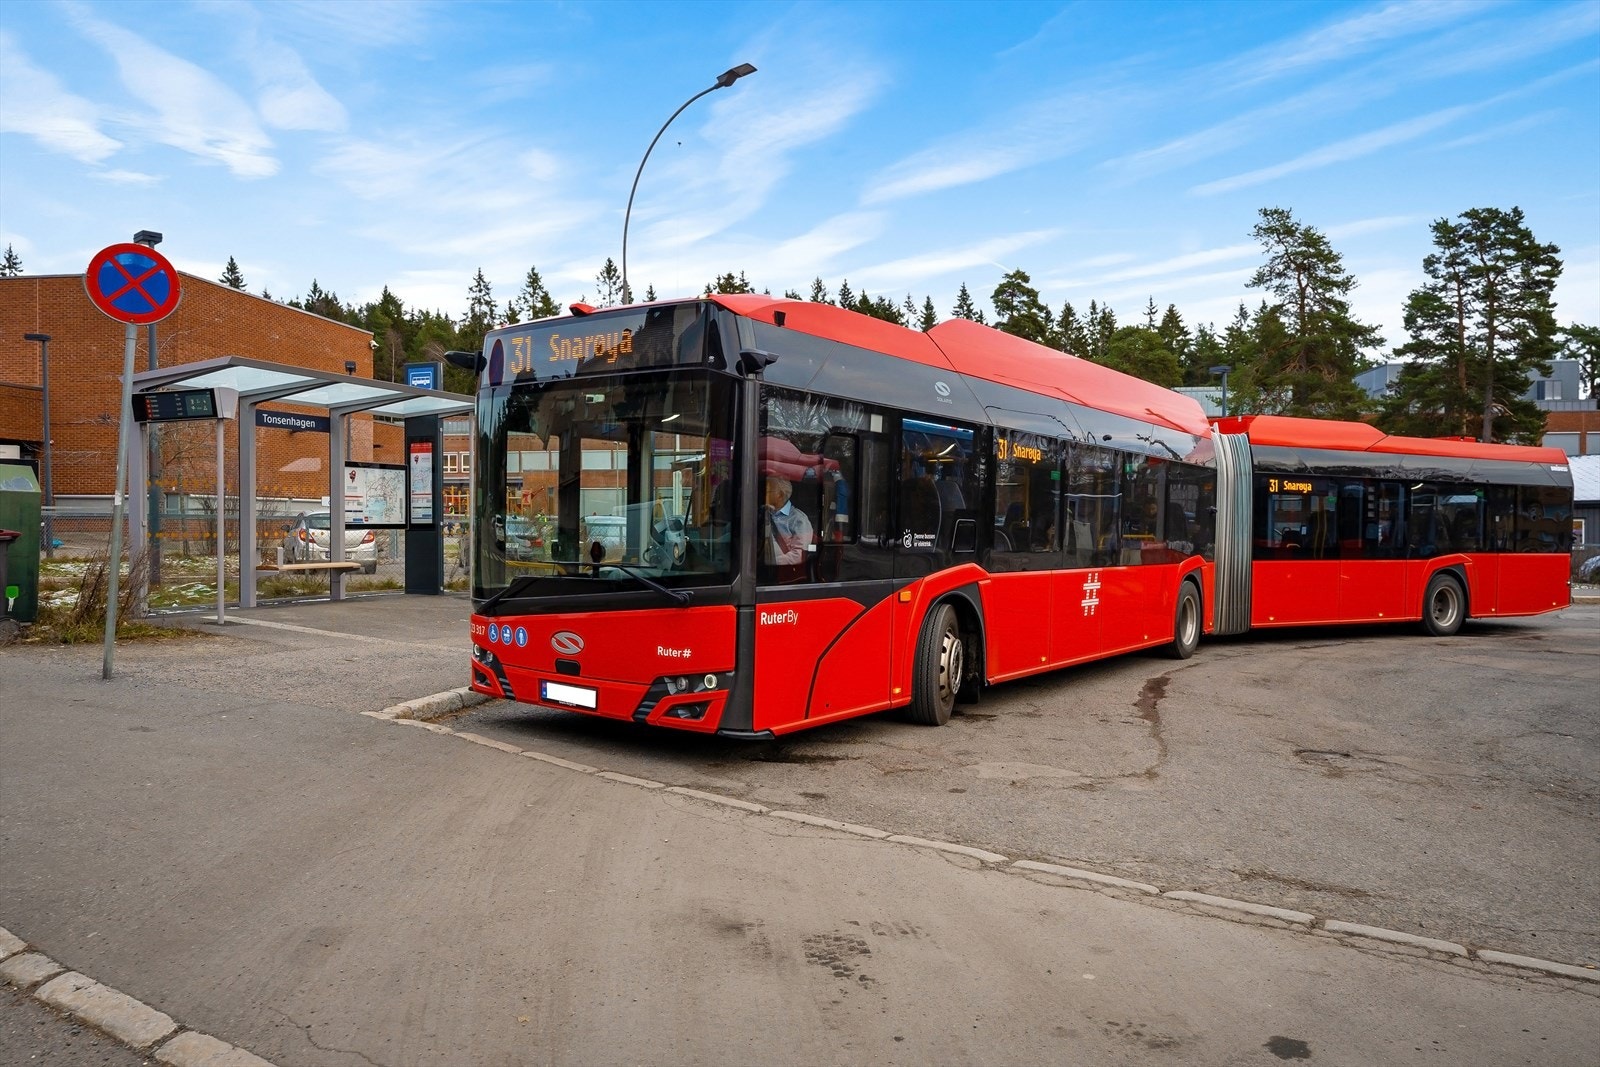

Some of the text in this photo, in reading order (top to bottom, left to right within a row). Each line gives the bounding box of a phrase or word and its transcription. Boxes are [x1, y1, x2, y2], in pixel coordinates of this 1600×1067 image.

[510, 336, 532, 374] 31
[262, 413, 316, 429] Tonsenhagen
[998, 438, 1008, 460] 31
[1269, 479, 1279, 492] 31
[476, 624, 485, 635] 317
